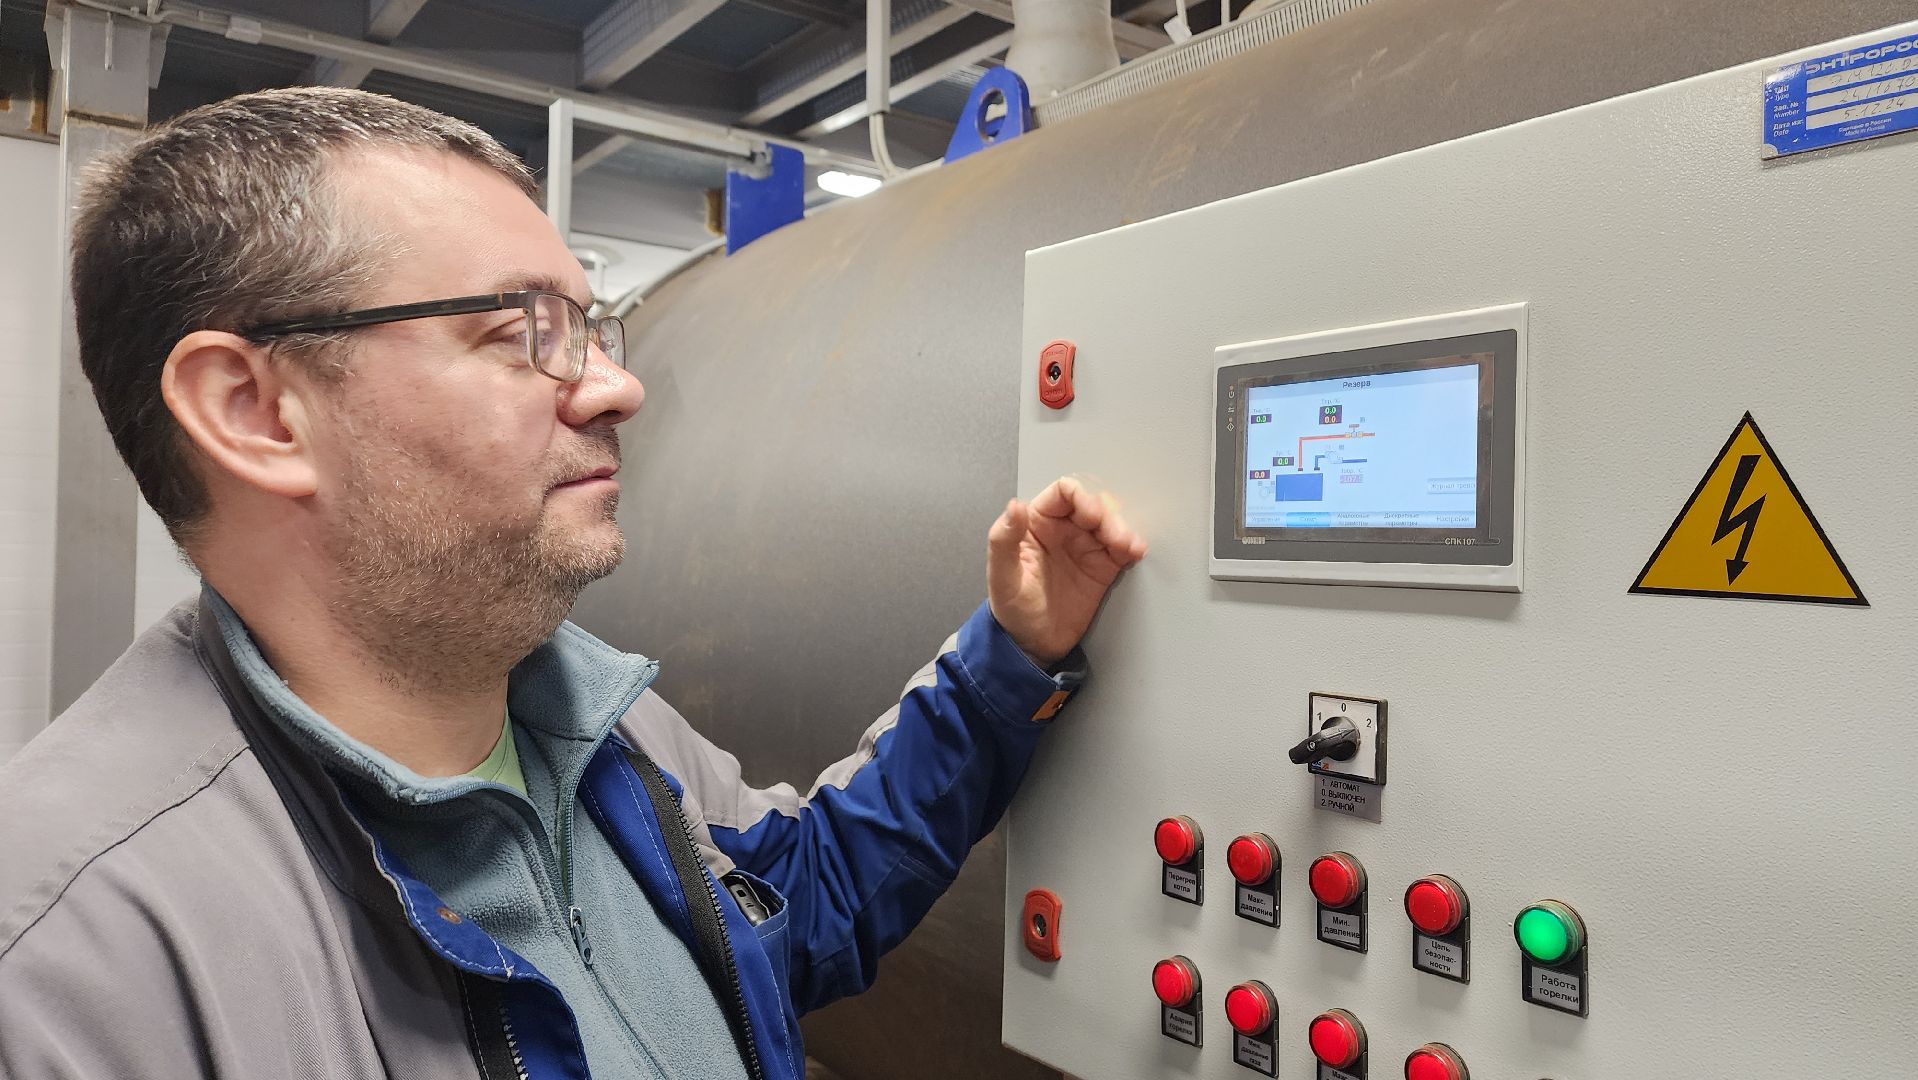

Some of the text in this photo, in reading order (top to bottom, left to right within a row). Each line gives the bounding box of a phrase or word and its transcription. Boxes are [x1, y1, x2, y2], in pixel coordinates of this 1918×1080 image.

[1324, 406, 1337, 415] 0.0
[1256, 414, 1267, 423] 0.0
[1277, 457, 1289, 466] 0.0
[1254, 470, 1265, 479] 0.0
[1341, 702, 1347, 713] 0
[1316, 712, 1322, 721] 1
[1366, 718, 1372, 728] 2
[1330, 780, 1361, 792] АВТОМАТ
[1328, 790, 1365, 804] ВЫКЛЮЧЕН
[1328, 799, 1355, 812] РУЧНОЙ
[1247, 893, 1266, 906] Макс.
[1240, 903, 1273, 918] давление
[1332, 916, 1350, 927] Мин.
[1323, 926, 1360, 939] давление
[1429, 960, 1451, 973] ности
[1541, 974, 1577, 991] Работа
[1539, 988, 1579, 1004] горелки
